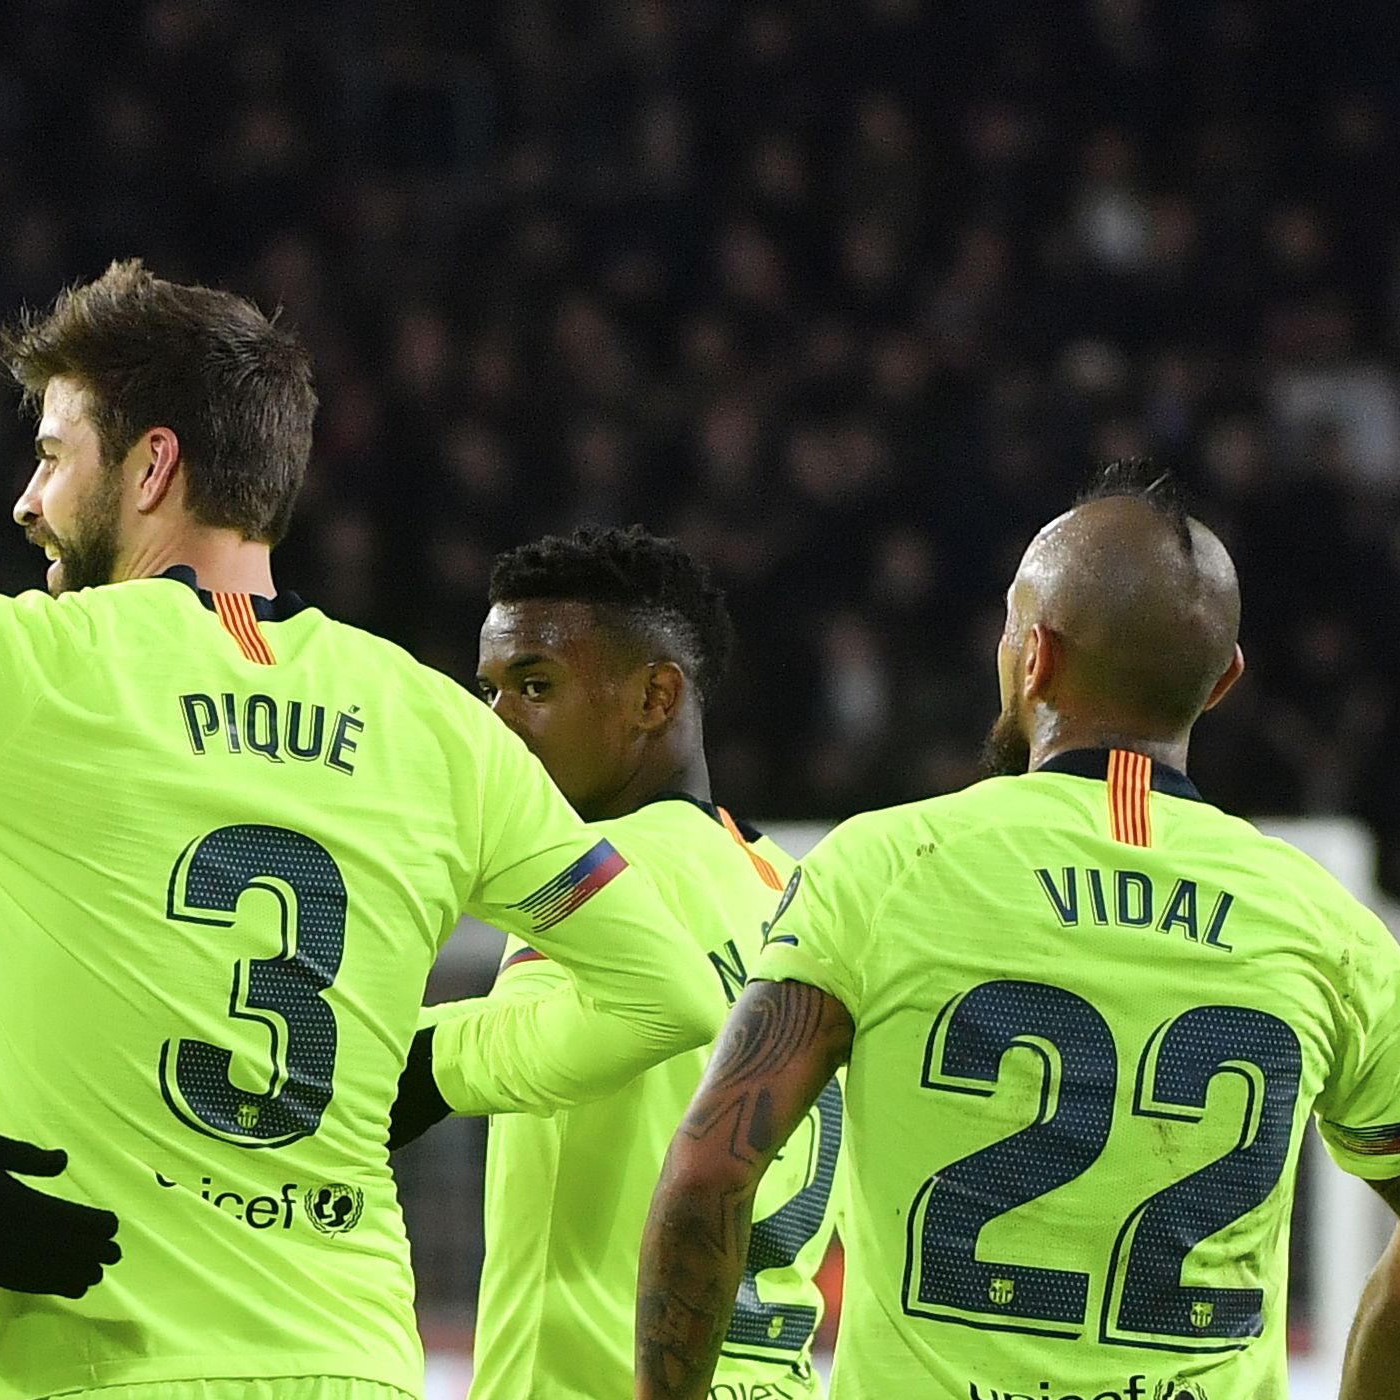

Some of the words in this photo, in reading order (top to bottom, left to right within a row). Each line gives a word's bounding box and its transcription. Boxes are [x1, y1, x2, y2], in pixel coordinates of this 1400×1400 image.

[181, 693, 364, 775] PIQUÉ
[159, 823, 348, 1149] 3
[1035, 866, 1234, 953] VIDAL
[902, 979, 1303, 1354] 22
